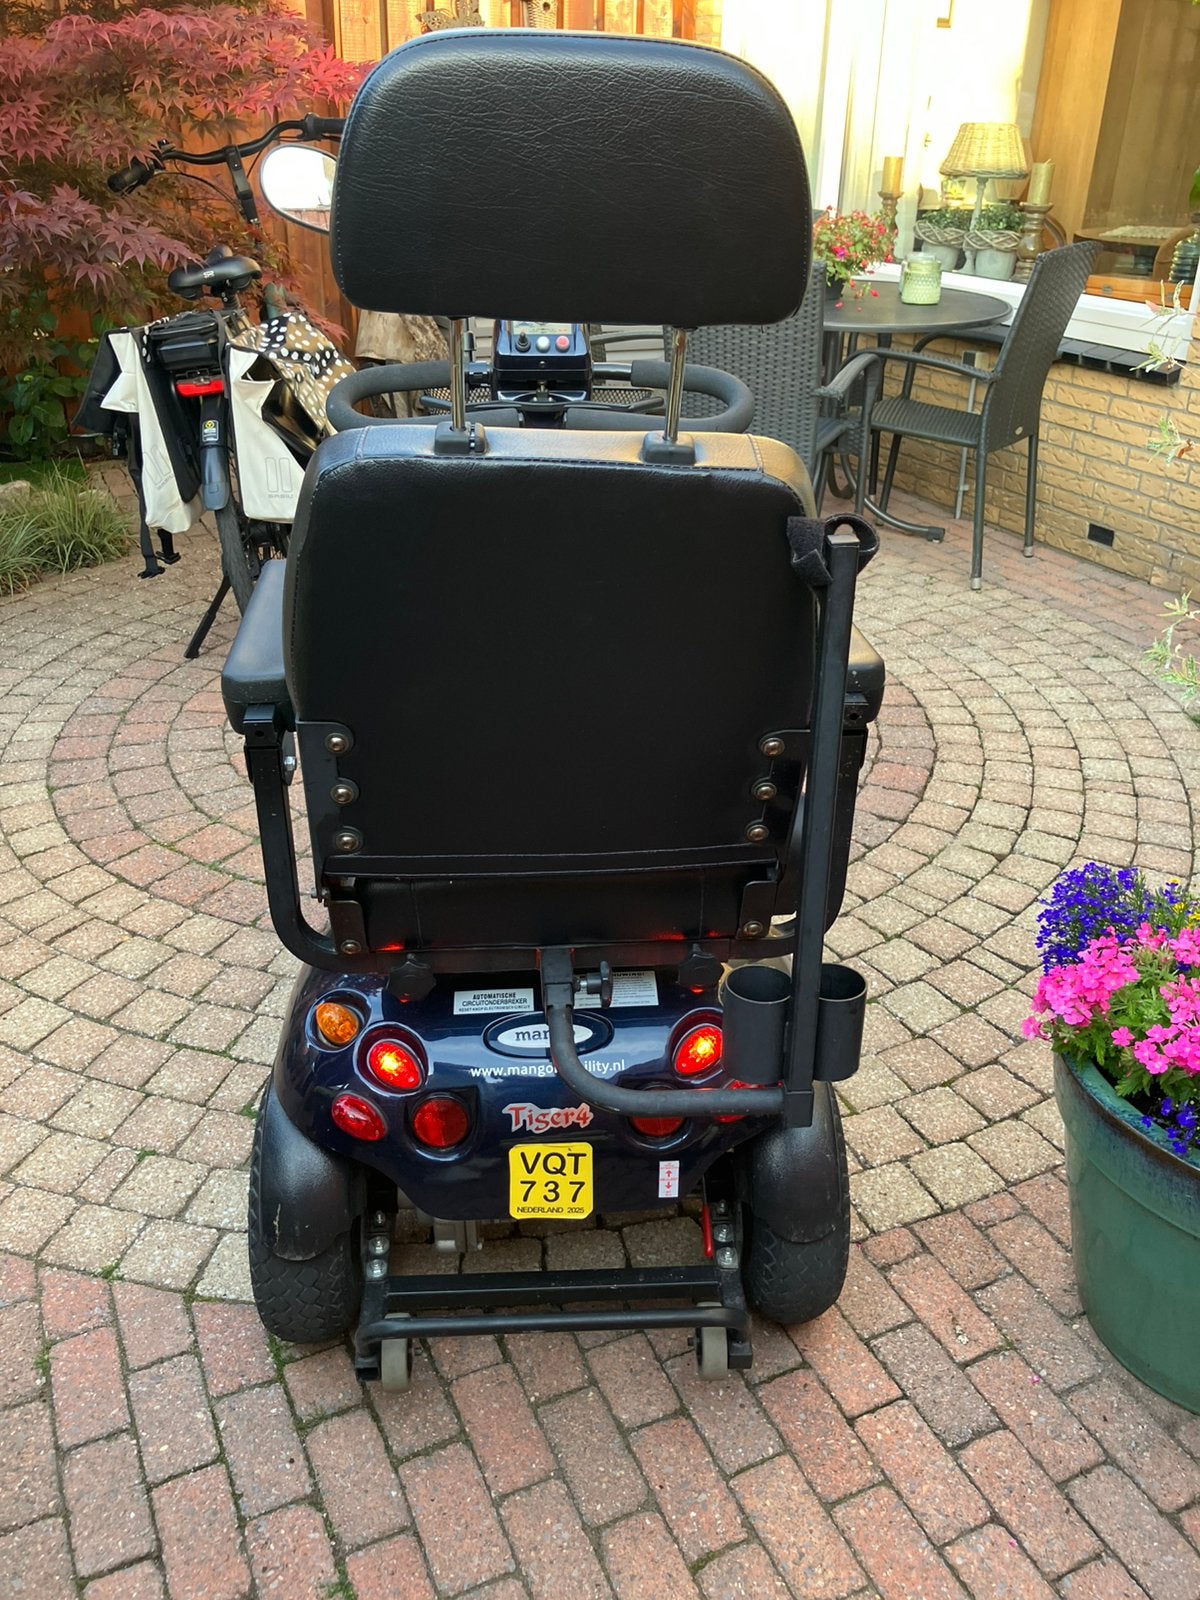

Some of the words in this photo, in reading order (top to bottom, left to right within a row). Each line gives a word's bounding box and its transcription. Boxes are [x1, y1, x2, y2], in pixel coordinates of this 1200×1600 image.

[462, 998, 527, 1007] CIRCUITONDERBREKER
[473, 992, 516, 1000] AUTOMATISCHE
[507, 1105, 590, 1131] Tiger4
[520, 1152, 587, 1176] VQT
[520, 1181, 586, 1203] 737
